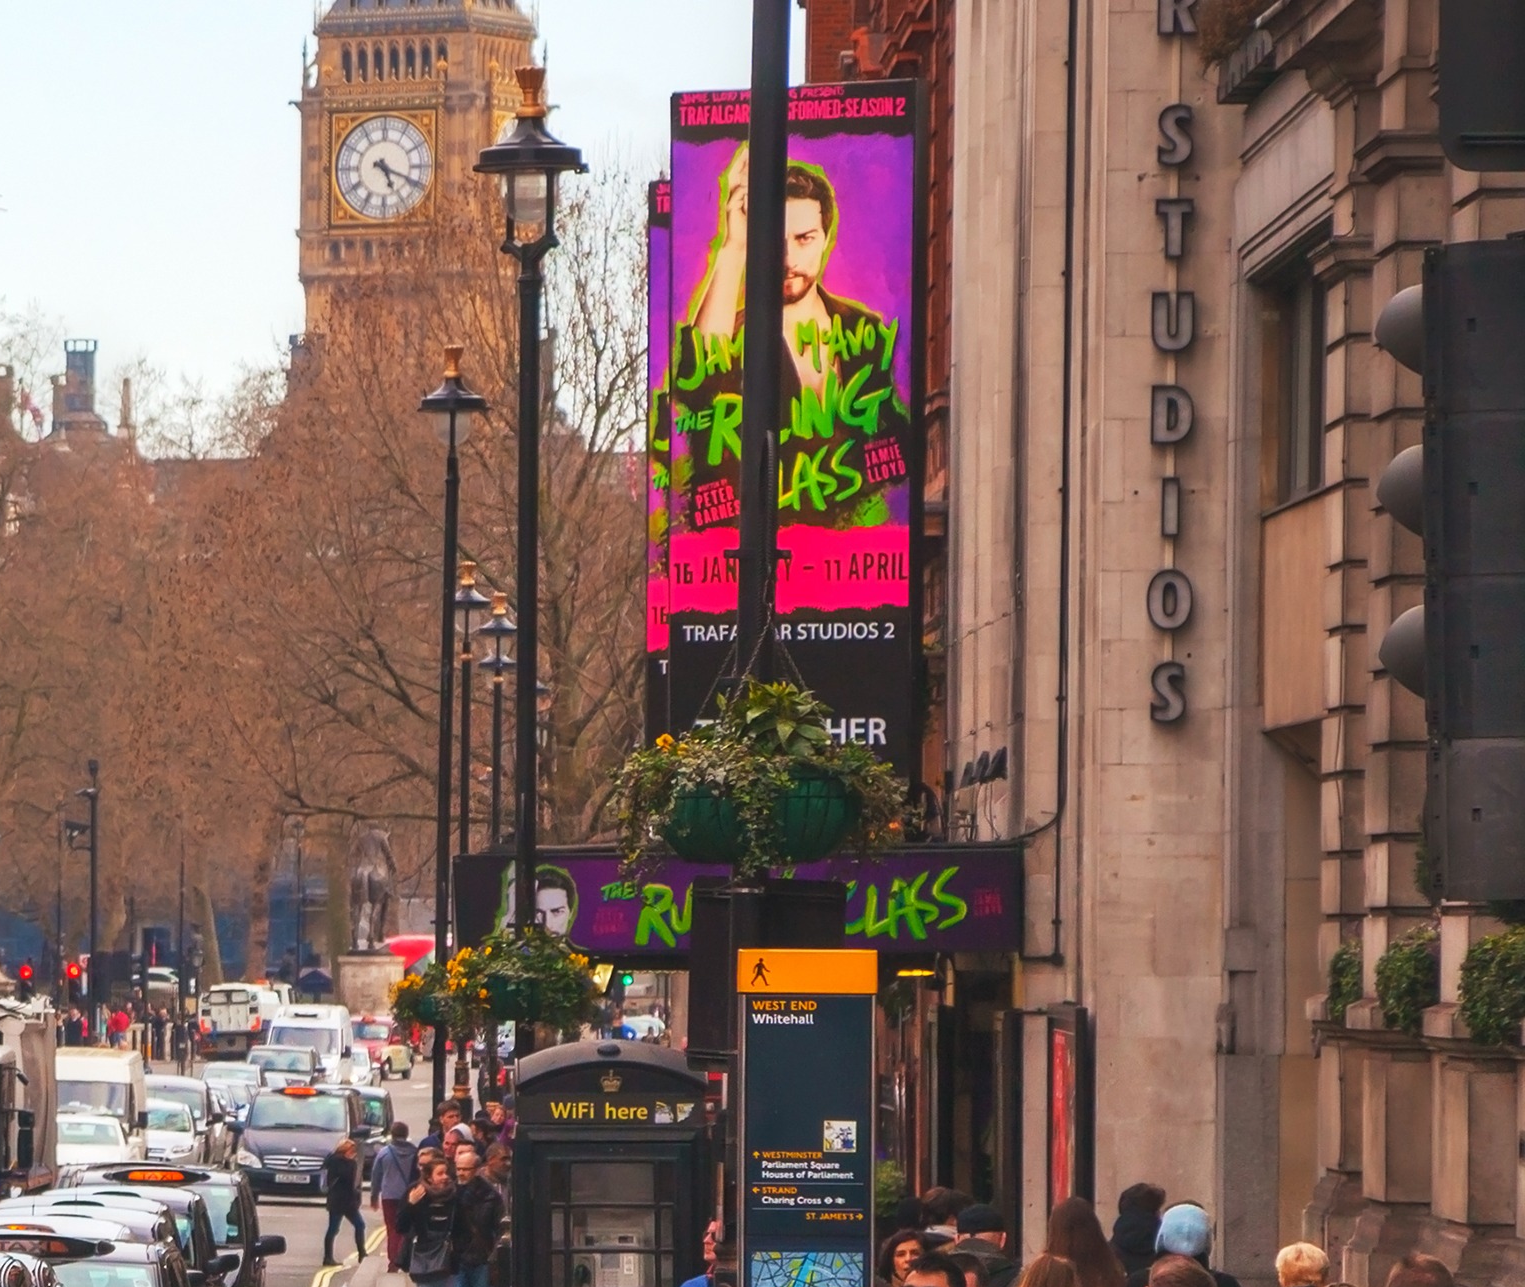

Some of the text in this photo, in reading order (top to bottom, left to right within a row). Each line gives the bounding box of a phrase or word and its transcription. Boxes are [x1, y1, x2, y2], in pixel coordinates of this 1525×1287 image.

[679, 103, 750, 126] TRAFALGAR
[895, 97, 906, 116] 2
[677, 325, 744, 390] JAM
[675, 409, 713, 434] THE
[1146, 103, 1195, 724] STUDIOS
[779, 438, 862, 511] LASS
[867, 460, 906, 483] LLOYD
[695, 485, 735, 510] PETER
[694, 499, 741, 527] BARNES
[674, 563, 694, 585] 16
[701, 556, 792, 584] JANY
[824, 559, 842, 581] 11
[849, 552, 909, 581] APRIL
[682, 622, 896, 642] TRAFAAR STUDIOS 2
[752, 1000, 818, 1011] WEST END
[752, 1013, 815, 1025] Whitehall
[550, 1101, 649, 1120] WiFi here
[761, 1160, 841, 1171] Parliament Square
[762, 1151, 824, 1160] WESTMINSTER
[140, 1171, 177, 1181] TAXI
[761, 1170, 855, 1180] Houses of Parliament
[761, 1195, 823, 1206] Charing Cross
[762, 1186, 798, 1195] STRAND
